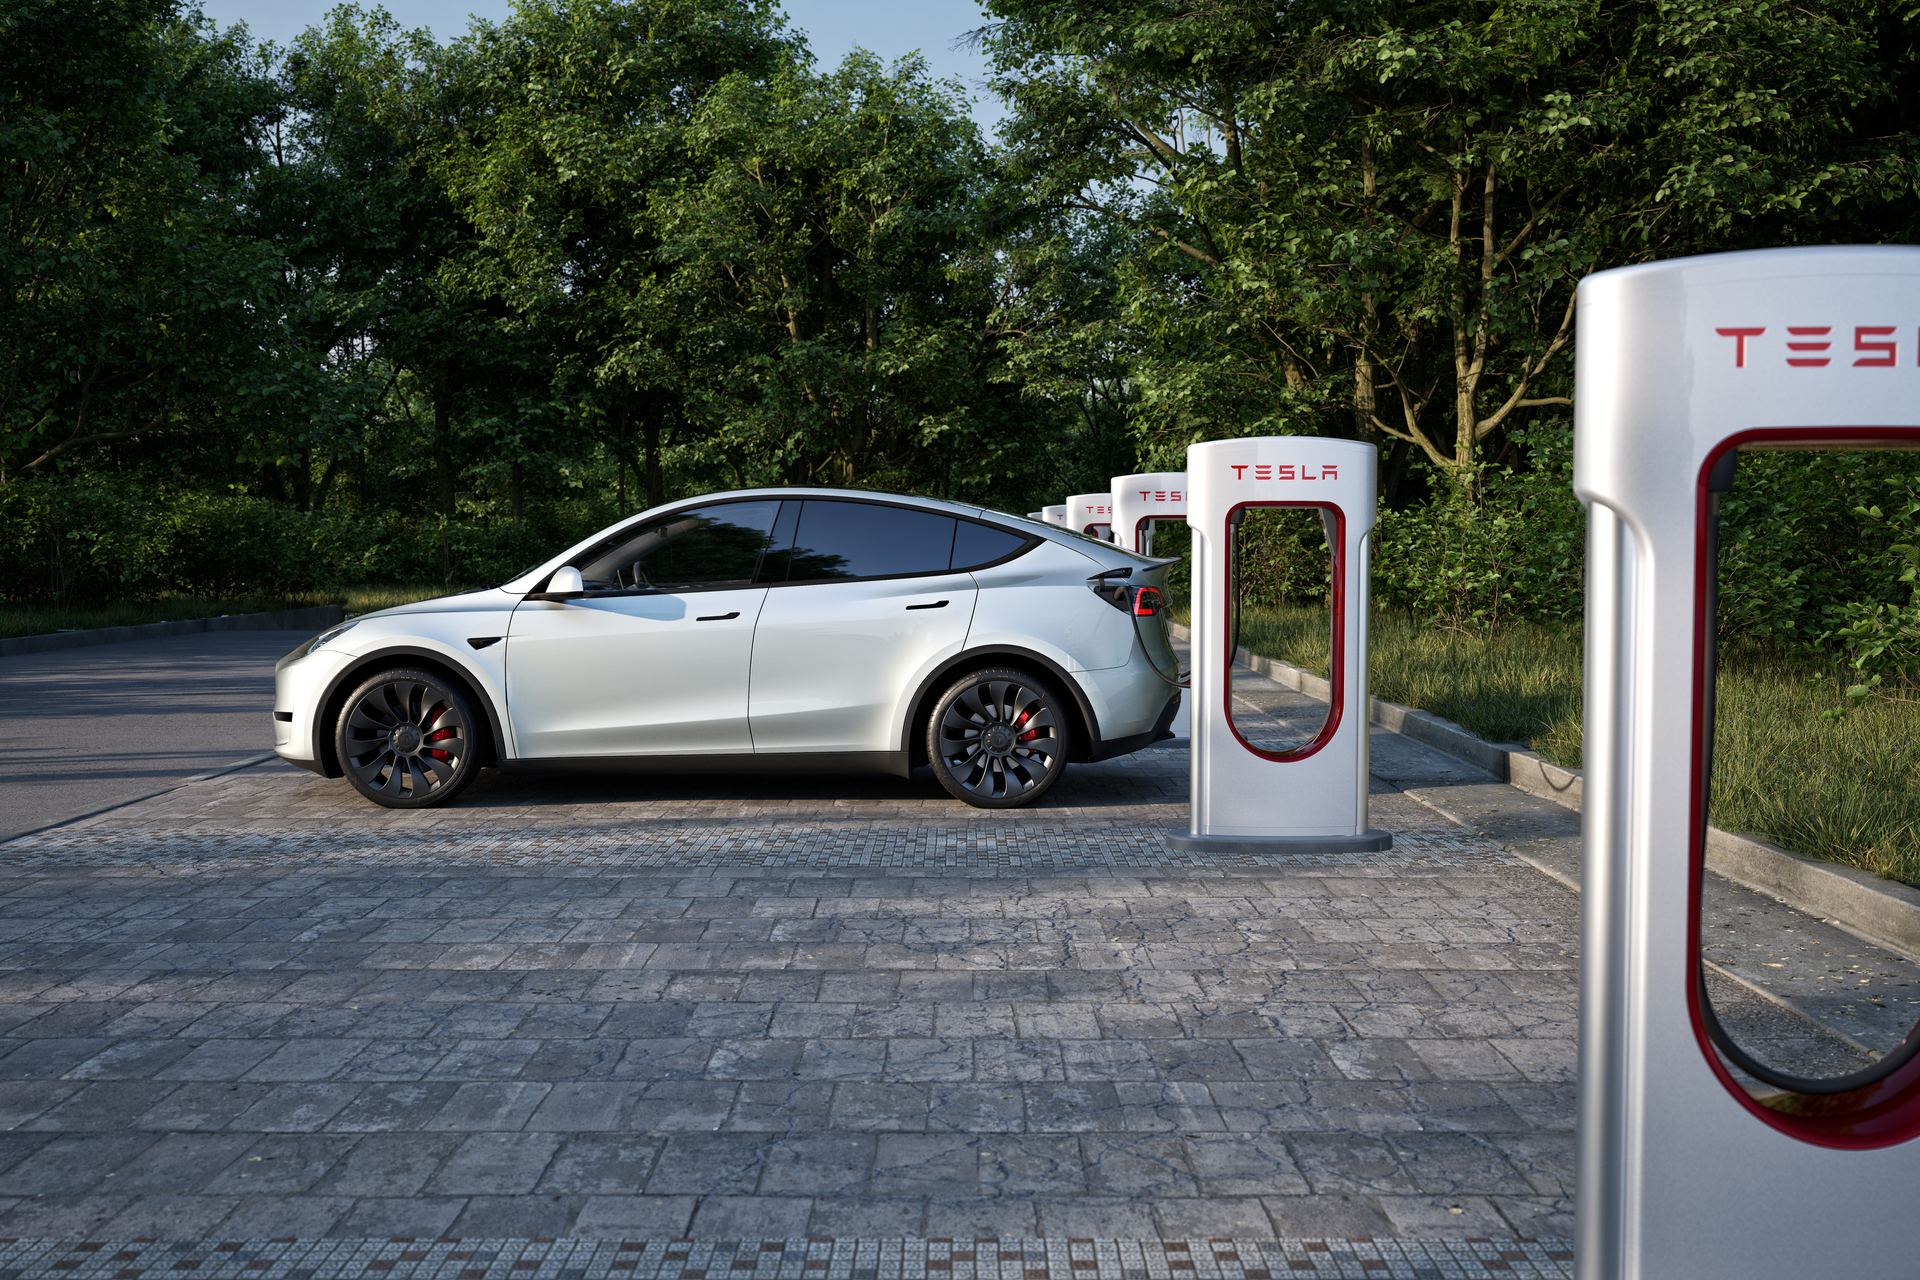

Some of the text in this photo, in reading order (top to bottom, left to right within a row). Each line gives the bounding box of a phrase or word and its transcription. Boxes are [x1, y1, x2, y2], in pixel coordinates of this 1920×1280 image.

[1715, 326, 1920, 368] TES
[1231, 464, 1338, 481] TESLA
[1139, 491, 1187, 502] TES
